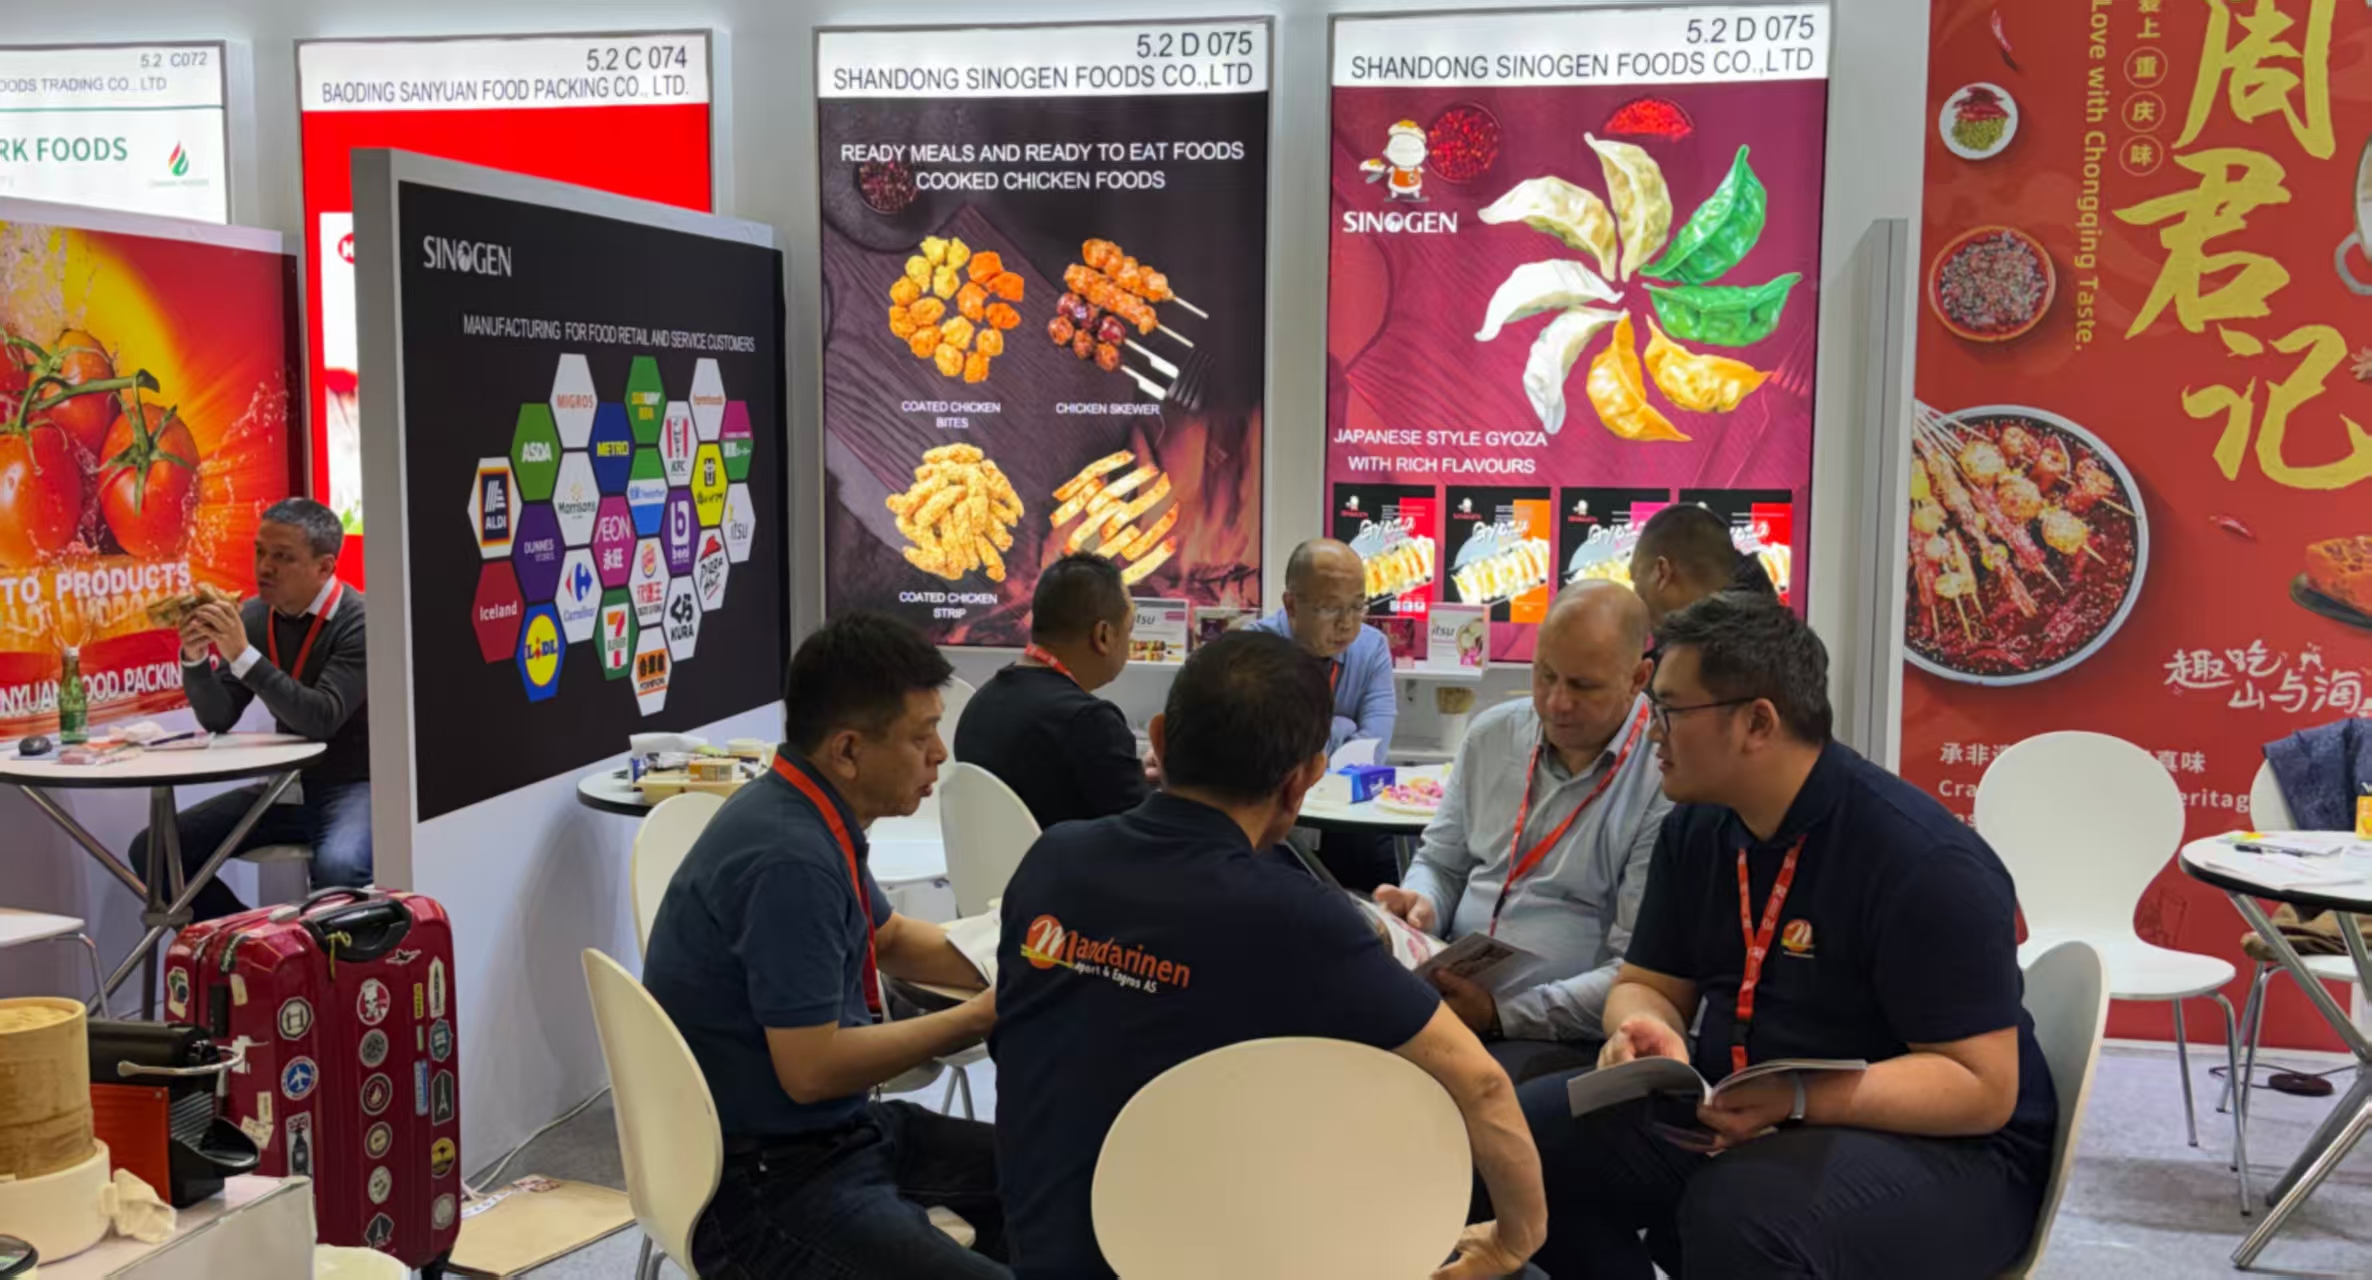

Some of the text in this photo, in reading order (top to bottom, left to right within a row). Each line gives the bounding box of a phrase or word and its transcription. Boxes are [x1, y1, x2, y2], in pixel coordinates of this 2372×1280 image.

[1686, 15, 1814, 45] 5.2 D 075
[1136, 31, 1253, 59] 5.2 D 075
[140, 52, 207, 68] 5.2 C072
[587, 46, 688, 72] 5.2 C 074
[1351, 56, 1488, 80] SHANDONG
[1496, 54, 1608, 79] SINOGEN
[1617, 51, 1705, 76] FOODS
[41, 78, 104, 92] TRADING
[834, 67, 959, 90] SHANDONG
[966, 66, 1068, 89] SINOGEN
[1076, 64, 1155, 88] FOODS
[322, 82, 395, 104] BAODING
[399, 80, 477, 102] SANYUAN
[482, 79, 529, 101] FOOD
[534, 77, 609, 99] PACKING
[37, 137, 128, 162] FOODS
[841, 142, 1244, 162] READY MEALS AND READY TO EAT FOODS
[916, 171, 1165, 190] COOKED CHICKEN FOODS
[2074, 0, 2112, 351] Love with Chongqing Taste.
[1343, 210, 1457, 235] SINOGEN
[423, 235, 512, 277] SINOGEN
[463, 314, 755, 352] MANUFACTURING FOR FOOD RETAIL AND SERVICE CUSTOMERS
[901, 401, 1001, 415] COATED CHICKEN
[1056, 402, 1160, 415] CHICKEN SKEWER
[936, 417, 968, 429] BITES
[1333, 428, 1547, 448] JAPANESE STYLE GYOZA
[1348, 456, 1535, 474] WITH RICH FLAVOURS
[485, 515, 508, 530] ALDI
[56, 560, 192, 602] PRODUCTS
[899, 591, 998, 606] COATED CHICKEN
[480, 601, 518, 621] Iceland
[933, 606, 966, 619] STRIP
[1135, 613, 1155, 625] tsu
[83, 670, 120, 703] OOD
[124, 661, 183, 694] PACKIN
[2178, 788, 2250, 813] eritag
